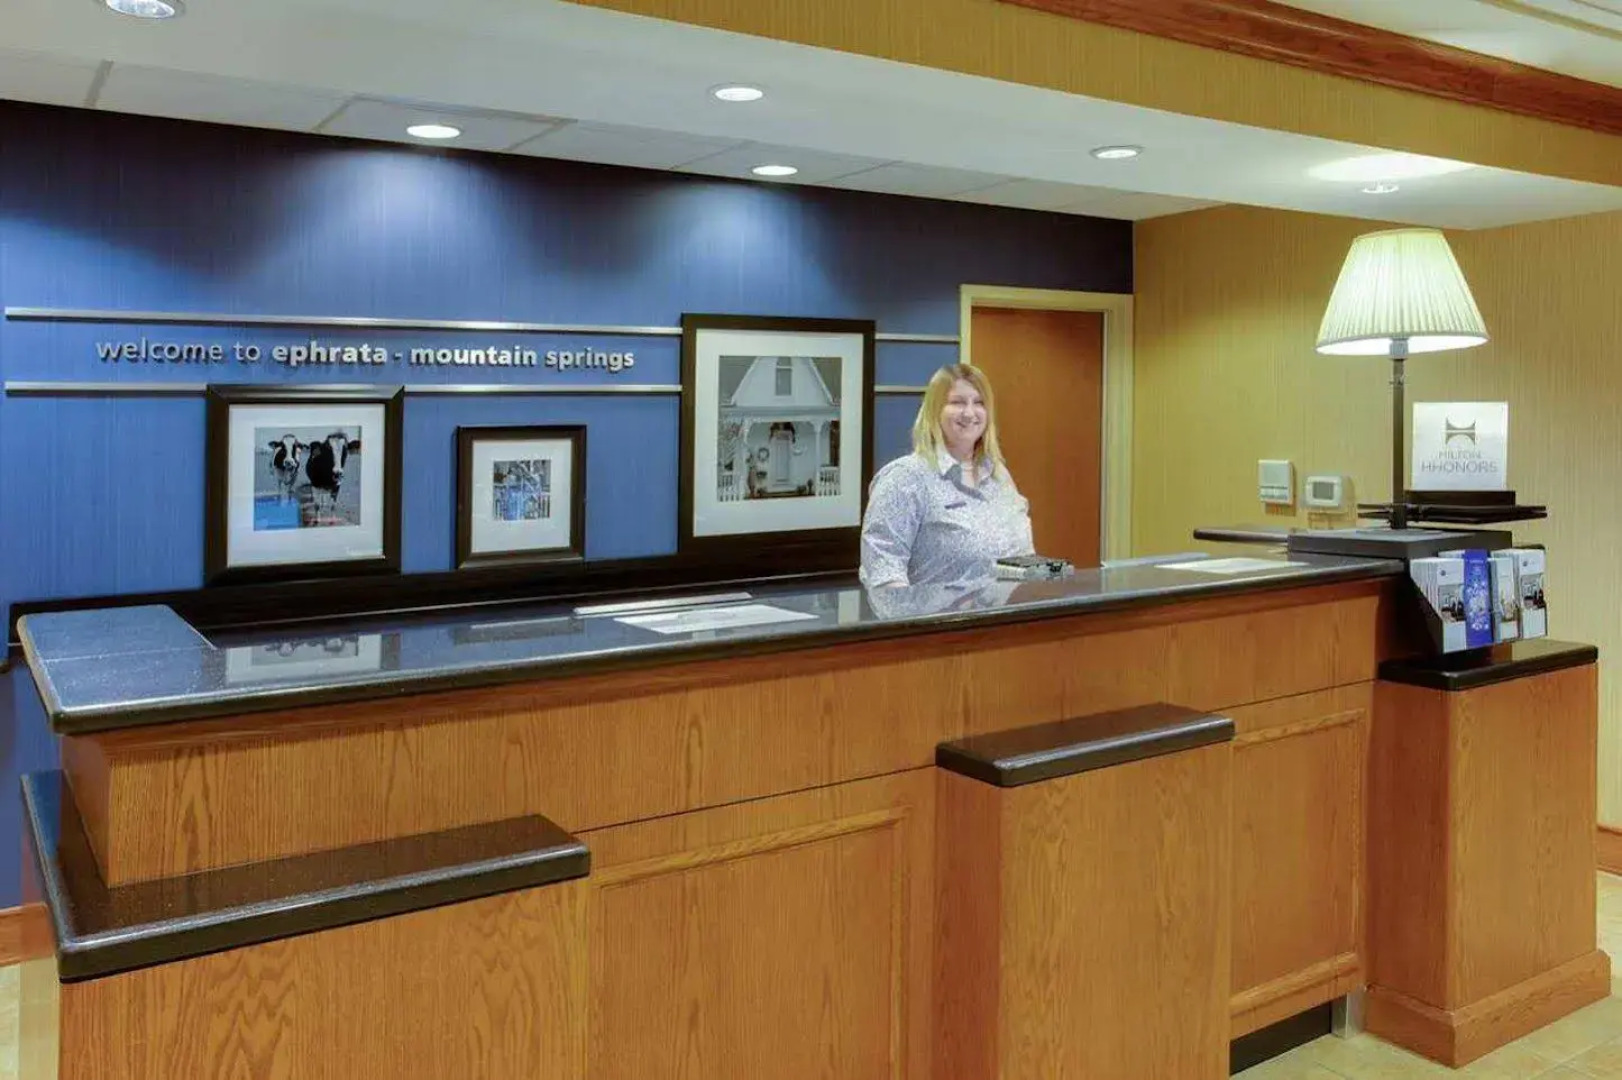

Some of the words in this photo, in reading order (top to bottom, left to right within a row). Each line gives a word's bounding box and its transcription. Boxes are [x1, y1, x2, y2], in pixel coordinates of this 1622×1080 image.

[96, 337, 223, 361] welcome
[233, 341, 261, 361] to
[272, 340, 388, 366] ephrata
[411, 345, 537, 366] mountain
[545, 347, 634, 371] springs
[1438, 450, 1482, 460] HILTON
[1421, 460, 1498, 474] HHONORS
